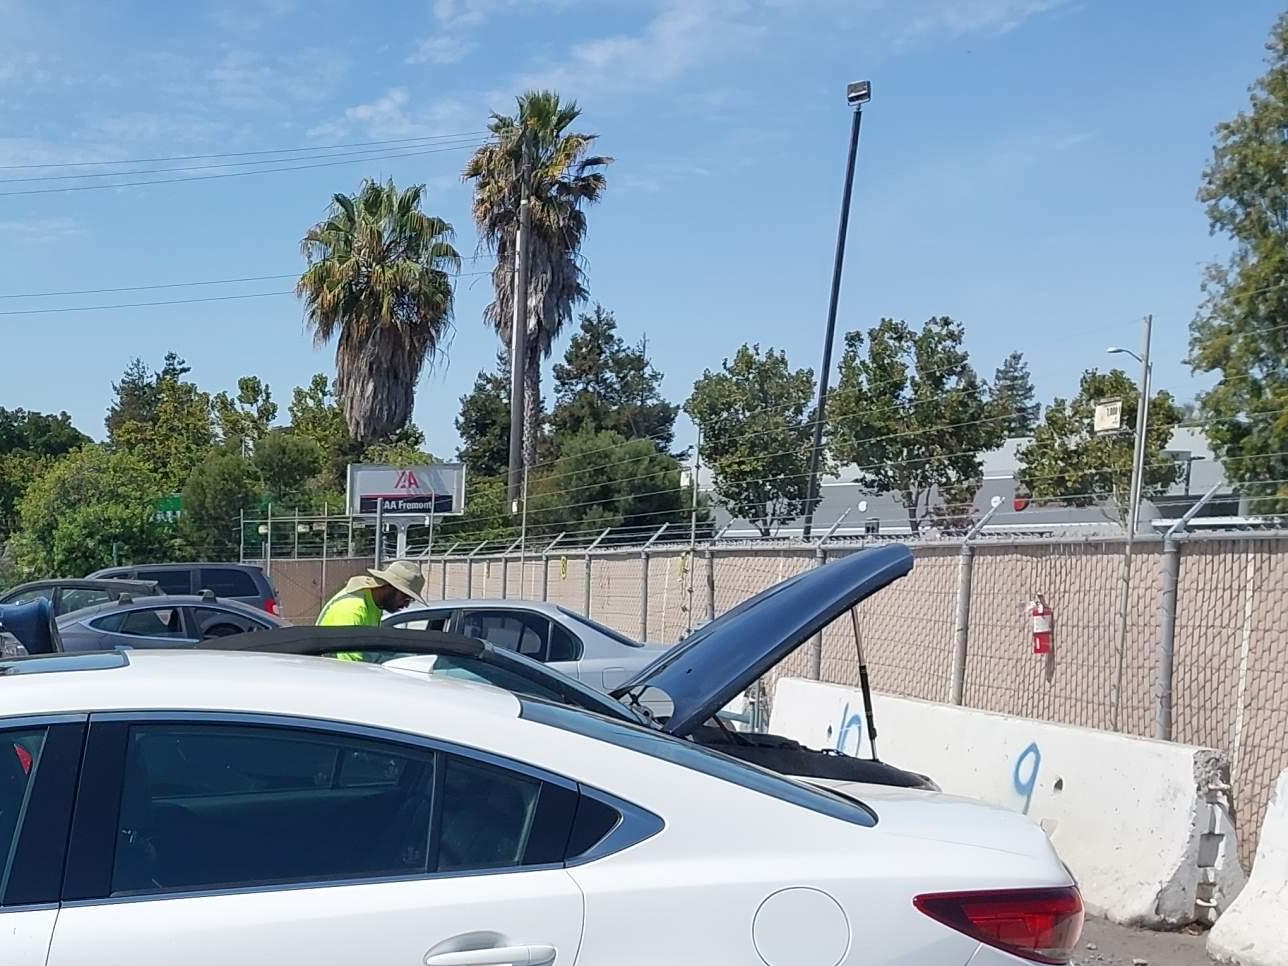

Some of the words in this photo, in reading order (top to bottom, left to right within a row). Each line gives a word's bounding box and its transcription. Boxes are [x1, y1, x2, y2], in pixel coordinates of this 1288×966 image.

[381, 500, 397, 510] AA
[398, 500, 432, 510] Fremont
[1013, 741, 1041, 815] 9
